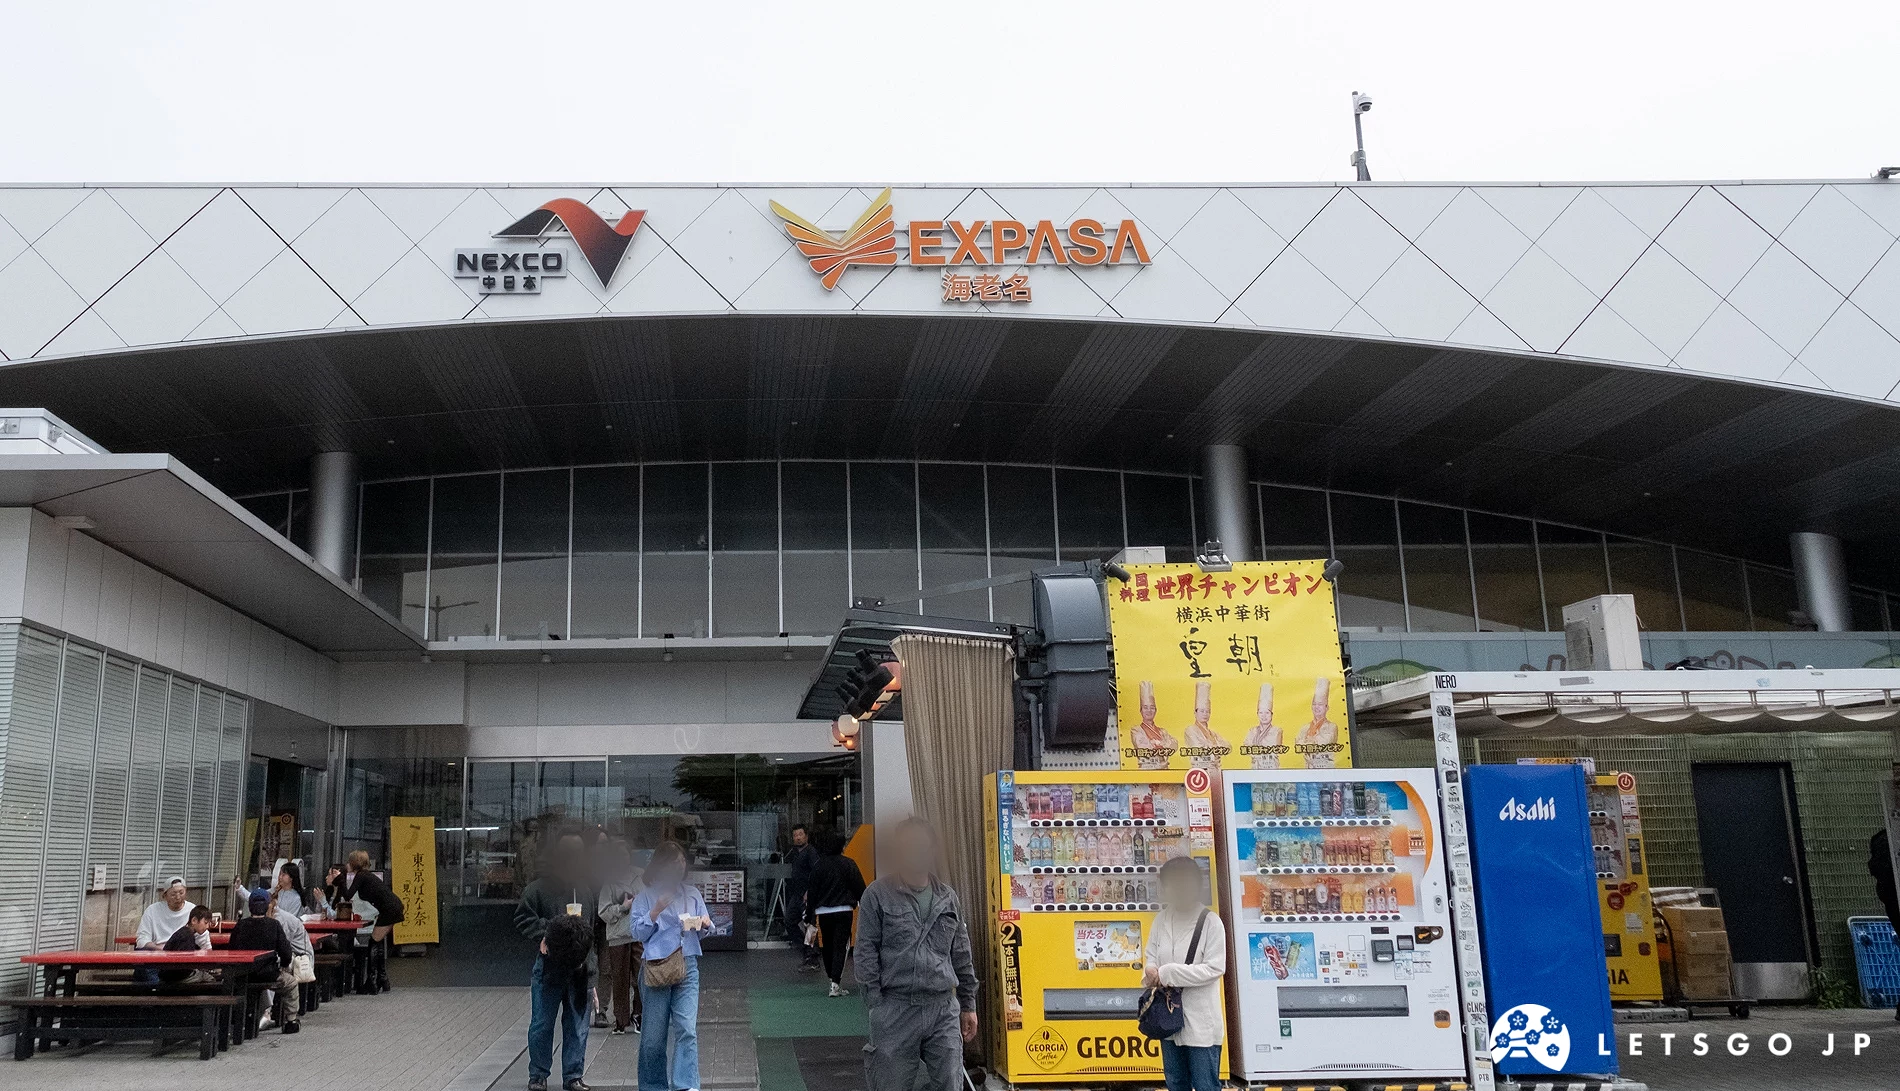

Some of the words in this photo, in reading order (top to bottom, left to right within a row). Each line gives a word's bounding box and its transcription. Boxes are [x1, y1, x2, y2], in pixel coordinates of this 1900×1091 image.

[908, 218, 1153, 266] EXPASA
[457, 253, 563, 271] NEXCO
[482, 275, 537, 290] 中日本
[942, 273, 1032, 303] 海老名
[1155, 572, 1323, 601] 世界チャンピオン
[1176, 604, 1271, 624] 横浜中華街
[1435, 675, 1457, 688] NERO
[1499, 797, 1556, 821] Asahi
[1028, 1043, 1066, 1052] GEORGIA
[1077, 1036, 1160, 1058] GEORG
